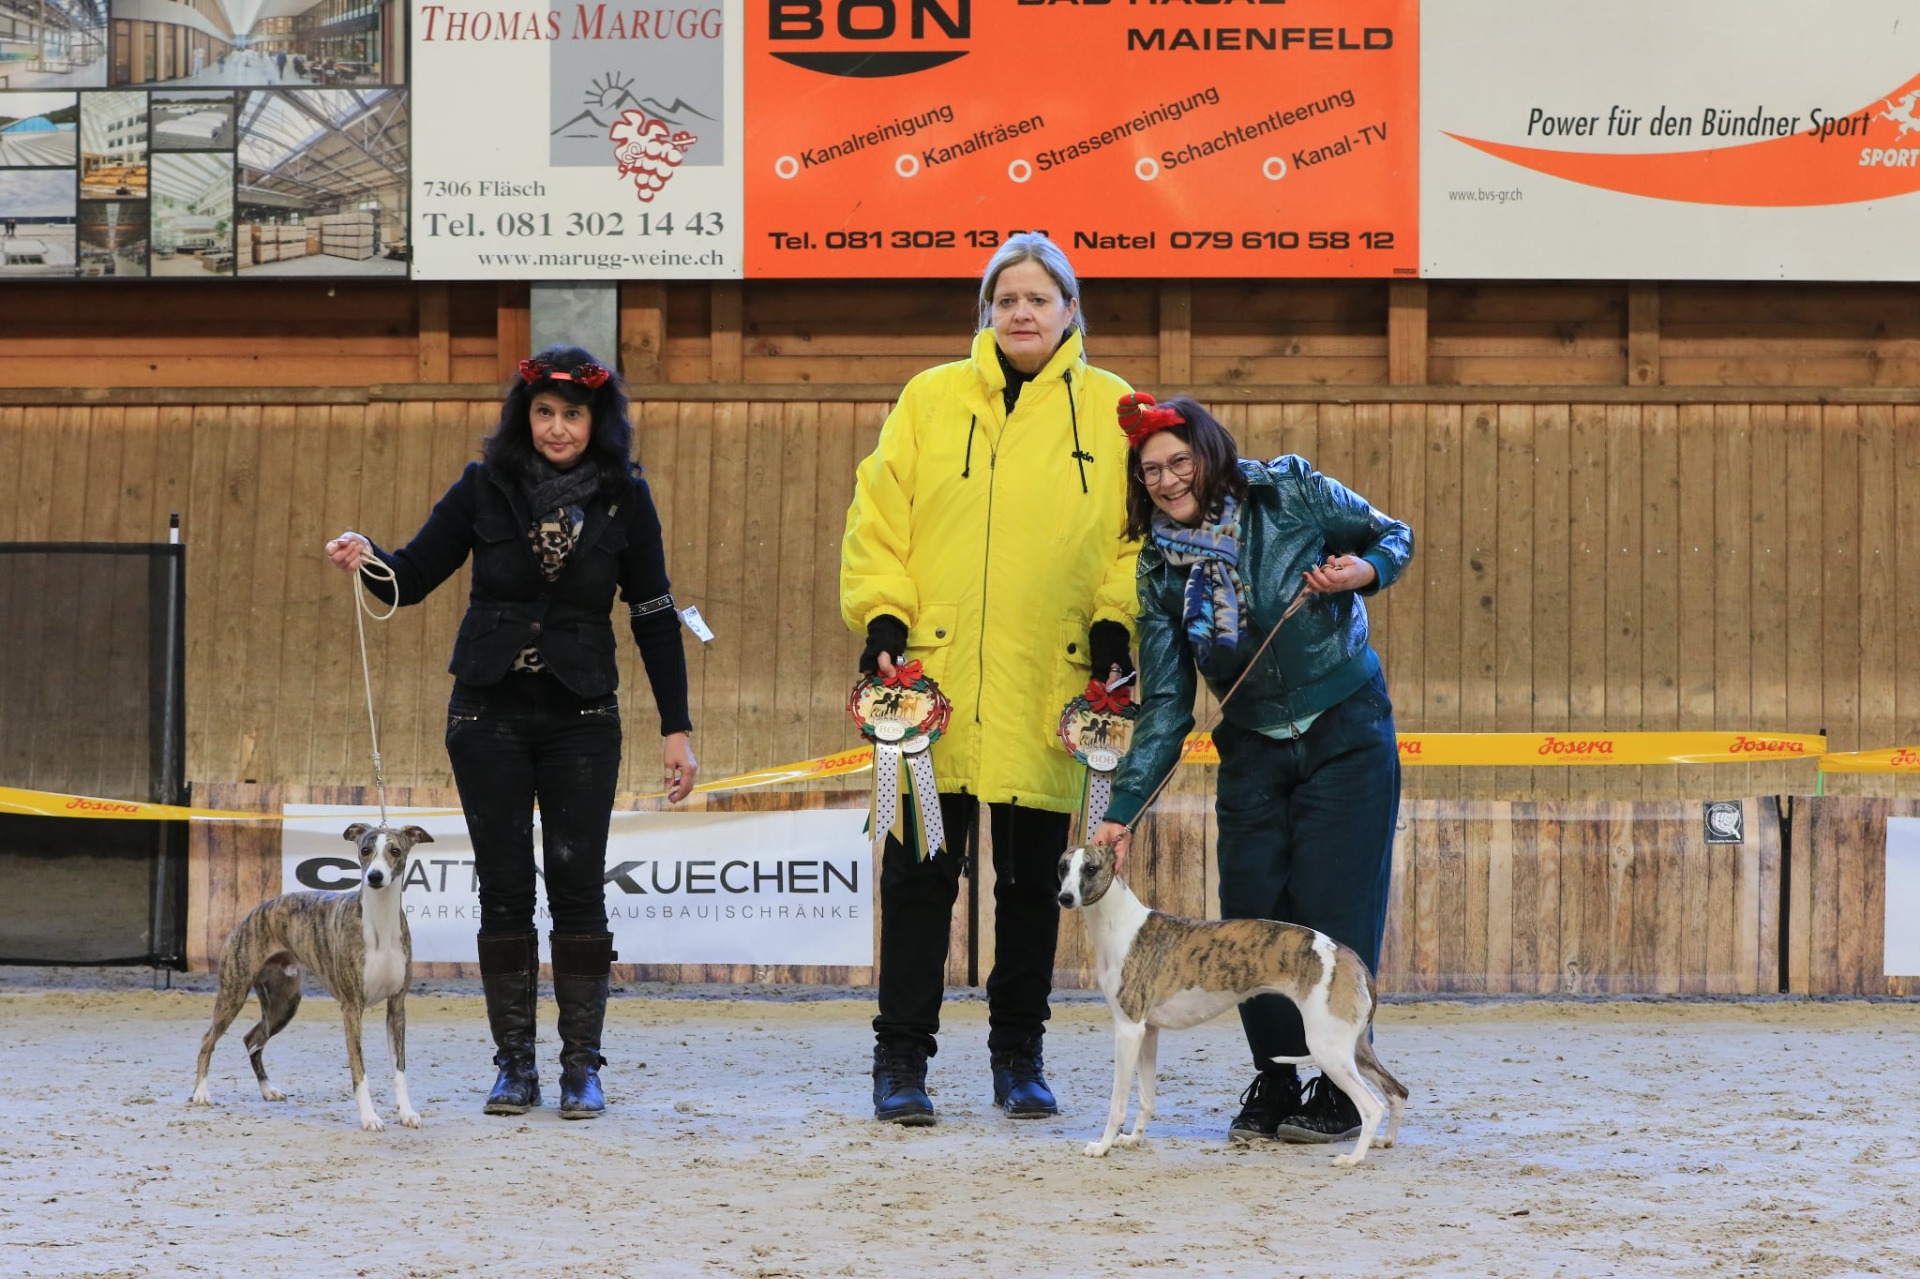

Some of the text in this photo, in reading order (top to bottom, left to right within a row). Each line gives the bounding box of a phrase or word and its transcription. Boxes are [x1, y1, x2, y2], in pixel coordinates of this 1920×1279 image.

[422, 4, 723, 41] THOMAS MARUGG
[1127, 27, 1393, 51] MAIENFELD
[1036, 86, 1220, 171] Strassenreinigung
[1161, 89, 1355, 170] Schachtentleerung
[1527, 105, 1871, 143] Power für den Bündner Sport
[800, 104, 954, 169] Kanalreinigung
[922, 113, 1045, 168] Kanalfräsen
[1292, 121, 1388, 170] Kanal-TV
[424, 180, 546, 197] 7306 Fläsch
[1448, 187, 1523, 204] www.bvs-gr.ch
[422, 212, 724, 237] Tel. 081 302 14 43
[768, 231, 817, 250] Tel.
[825, 231, 882, 249] 081
[891, 231, 955, 249] 302
[963, 230, 999, 249] 13
[1074, 231, 1395, 250] Natel 079 610 58 12
[477, 249, 724, 270] www.marugg-weine.ch
[1538, 737, 1613, 755] Josera
[1728, 736, 1804, 753] Josera
[66, 798, 139, 812] Josera
